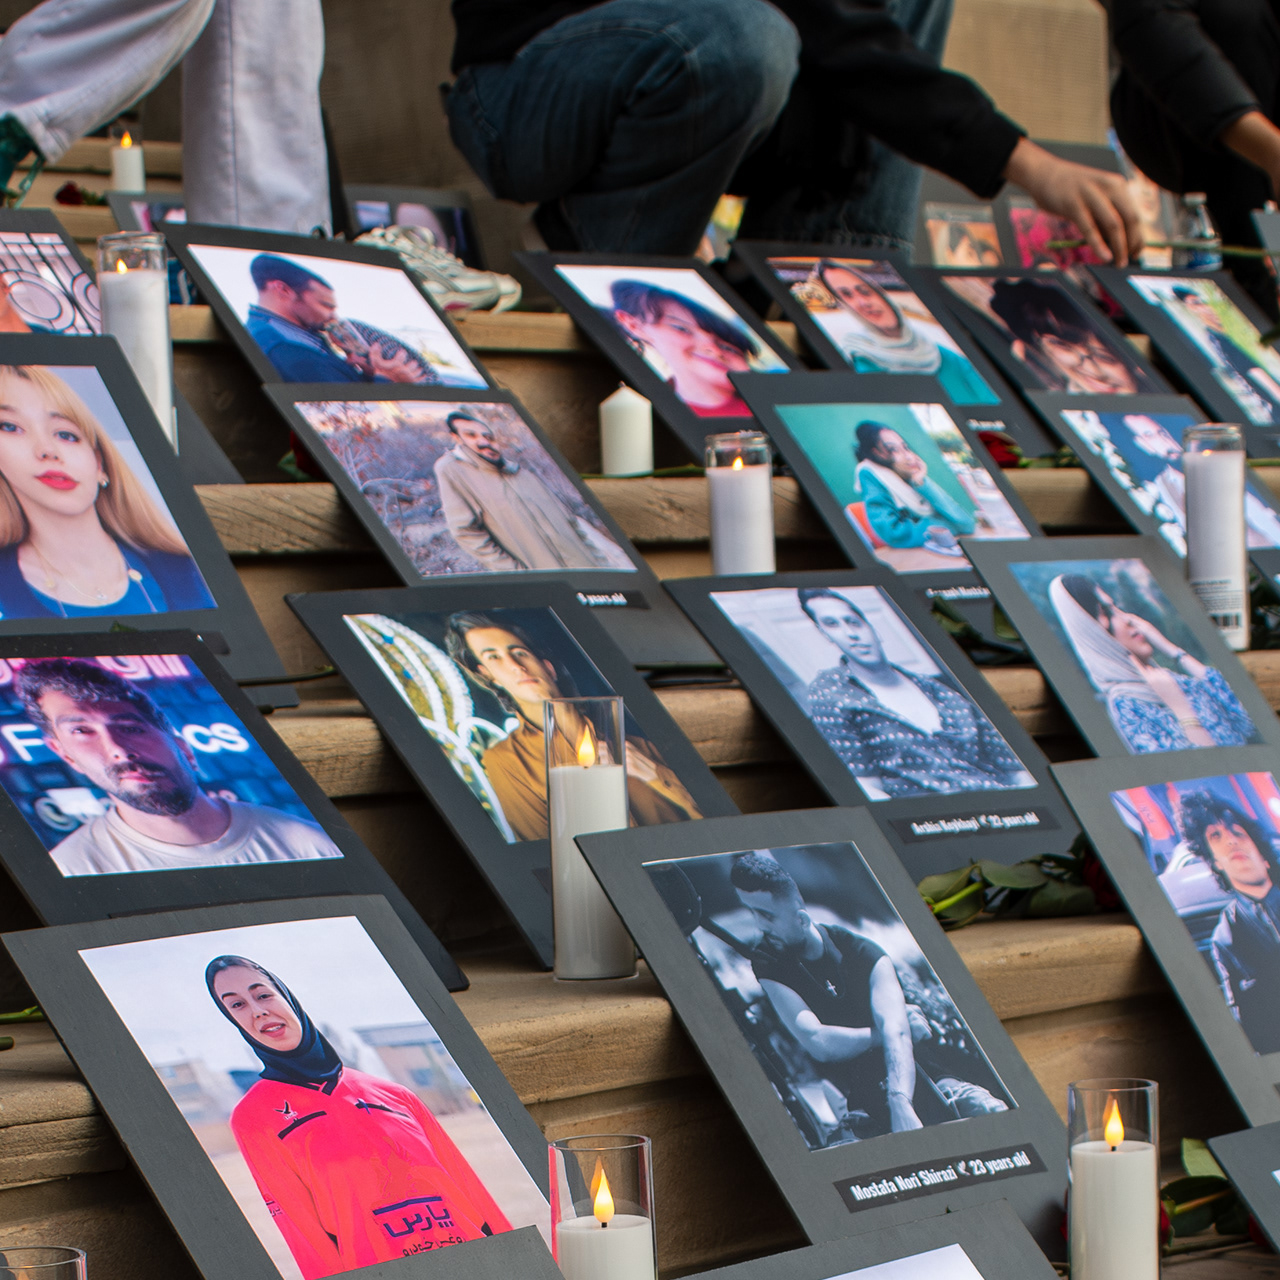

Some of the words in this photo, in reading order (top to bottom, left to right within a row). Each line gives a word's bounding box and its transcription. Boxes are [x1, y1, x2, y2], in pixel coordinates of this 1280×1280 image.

[849, 1178, 898, 1202] Mostafa
[893, 1172, 922, 1192] Nori
[917, 1164, 959, 1187] Shirazi
[968, 1159, 987, 1177] 23
[984, 1156, 1015, 1176] years
[1011, 1150, 1032, 1168] old
[382, 1203, 455, 1238] پارس
